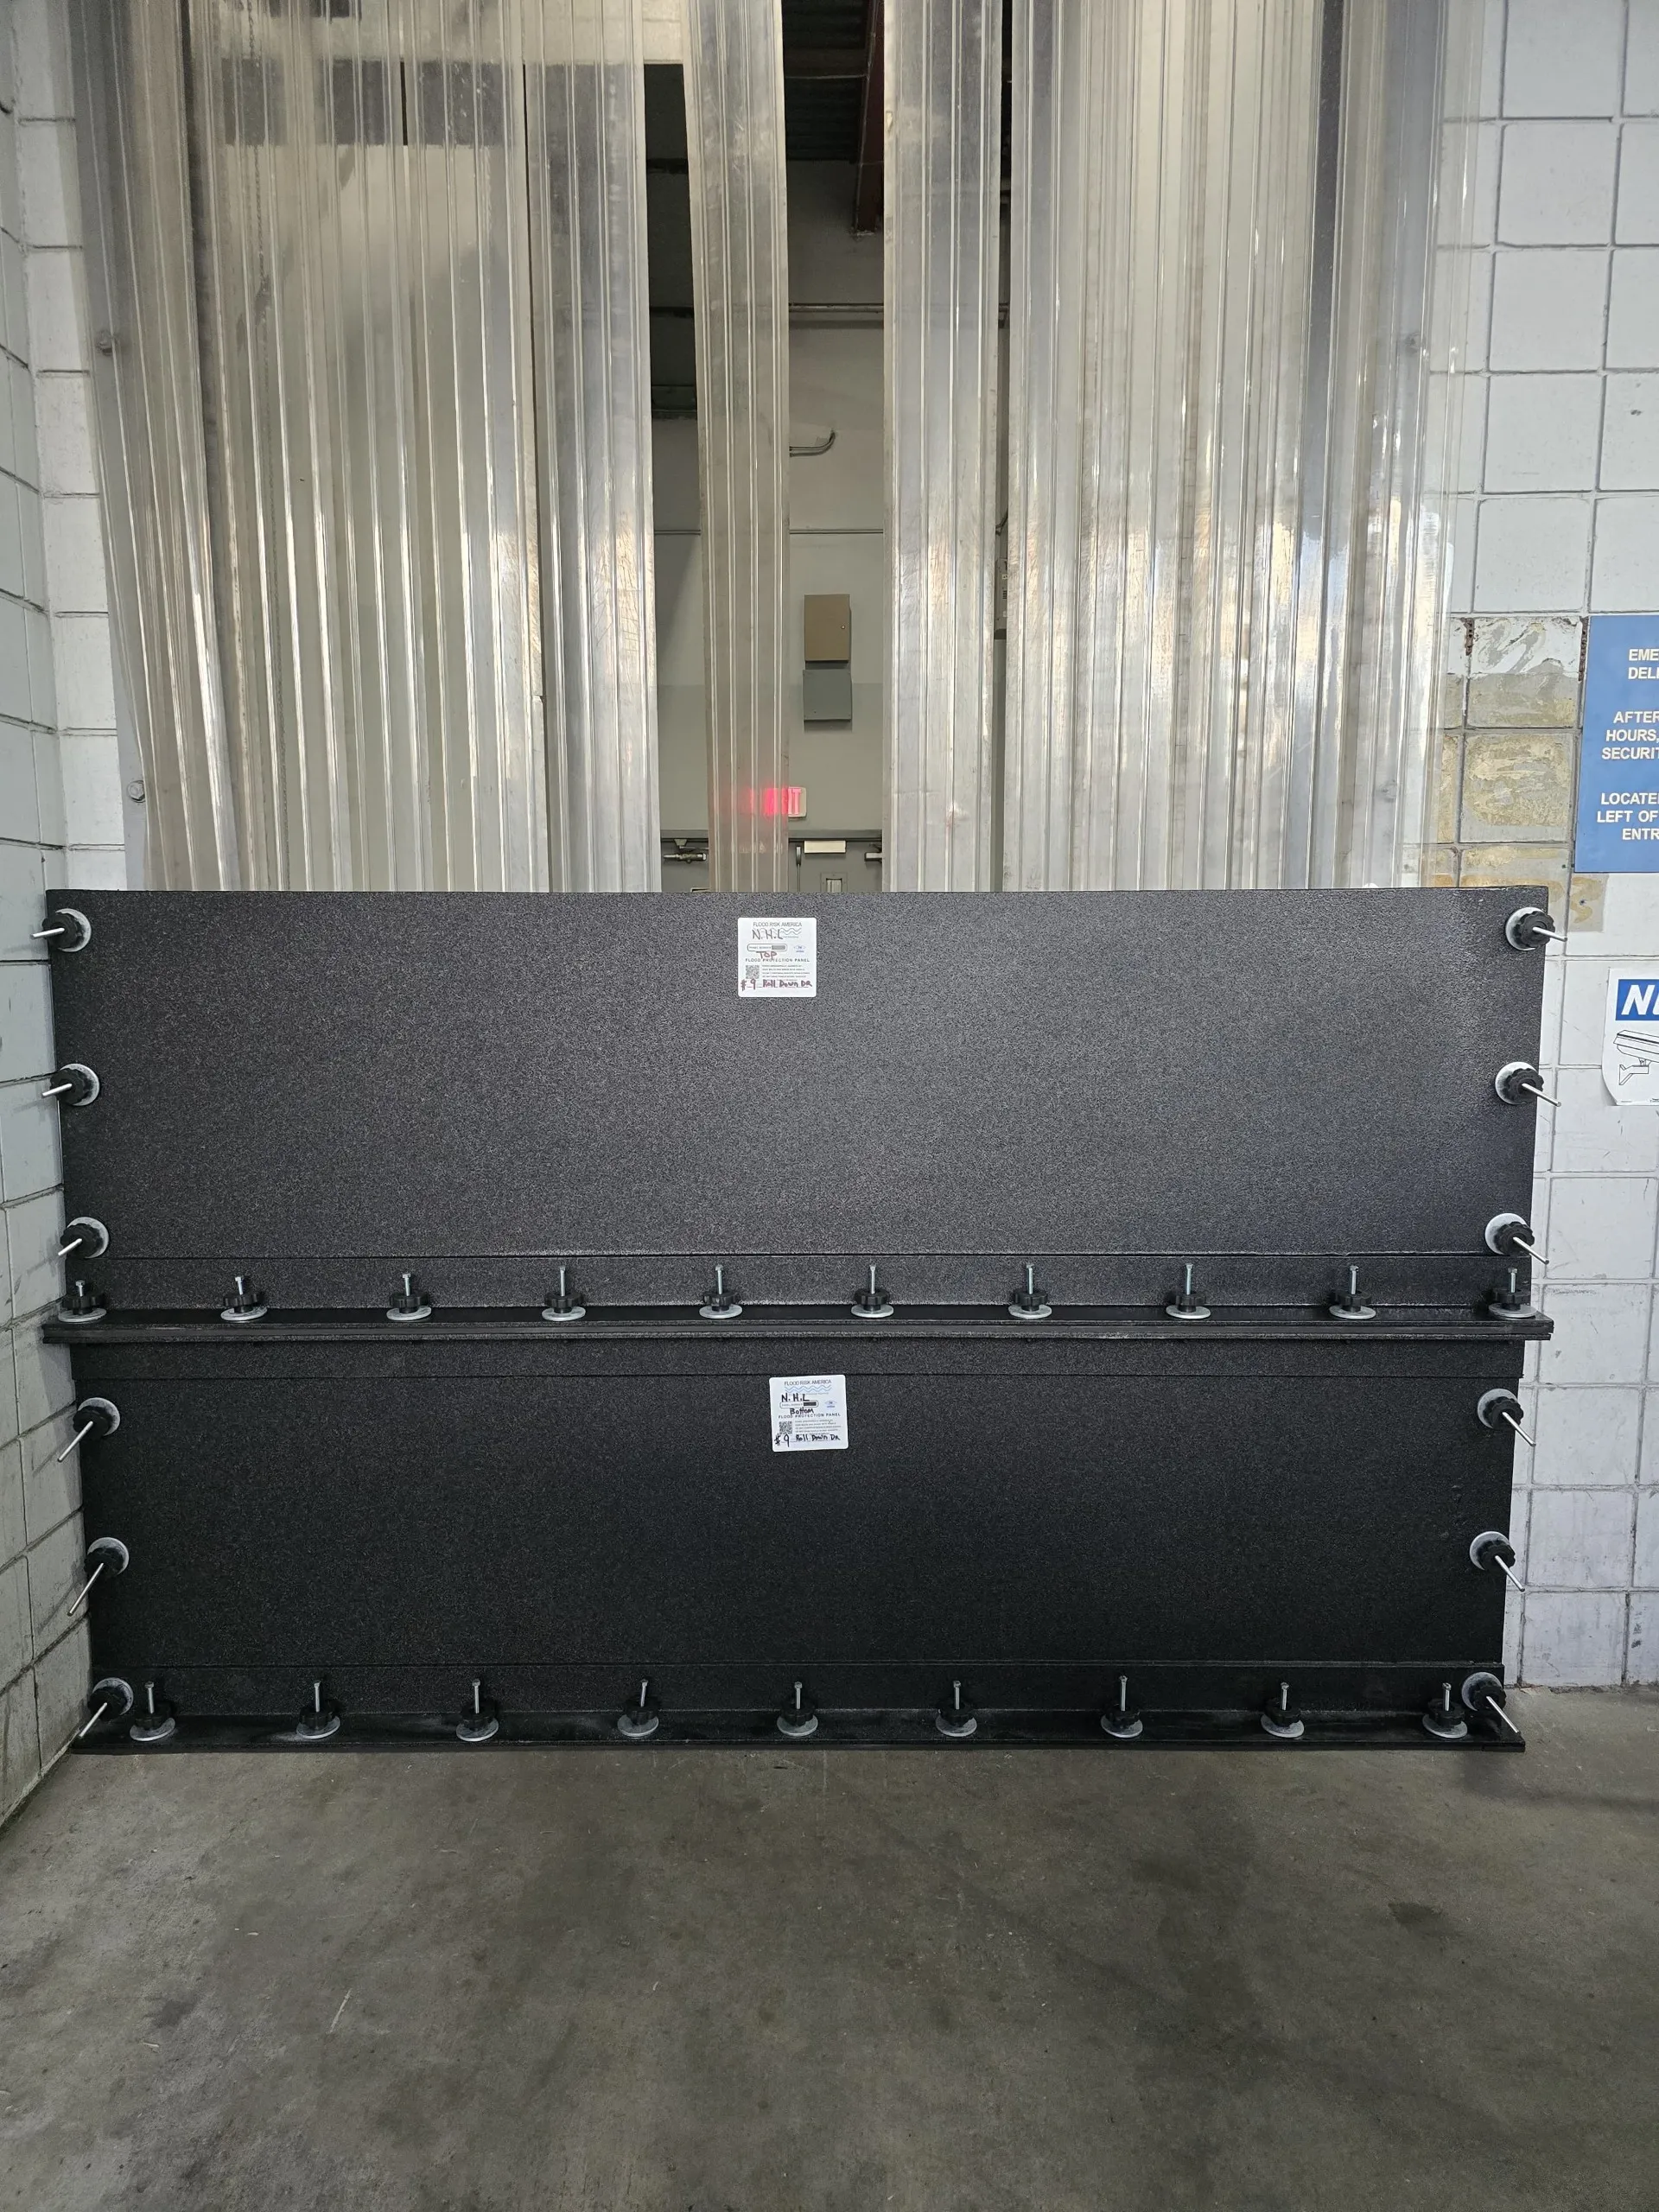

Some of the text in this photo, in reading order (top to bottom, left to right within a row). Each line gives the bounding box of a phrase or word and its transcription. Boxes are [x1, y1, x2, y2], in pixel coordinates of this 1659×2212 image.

[1613, 710, 1659, 724] AFTER
[1605, 728, 1659, 744] HOURS,
[1600, 792, 1659, 805] LOCATE
[1597, 810, 1659, 823] LEFT OF
[1622, 828, 1659, 841] ENTR
[1621, 984, 1659, 1015] N
